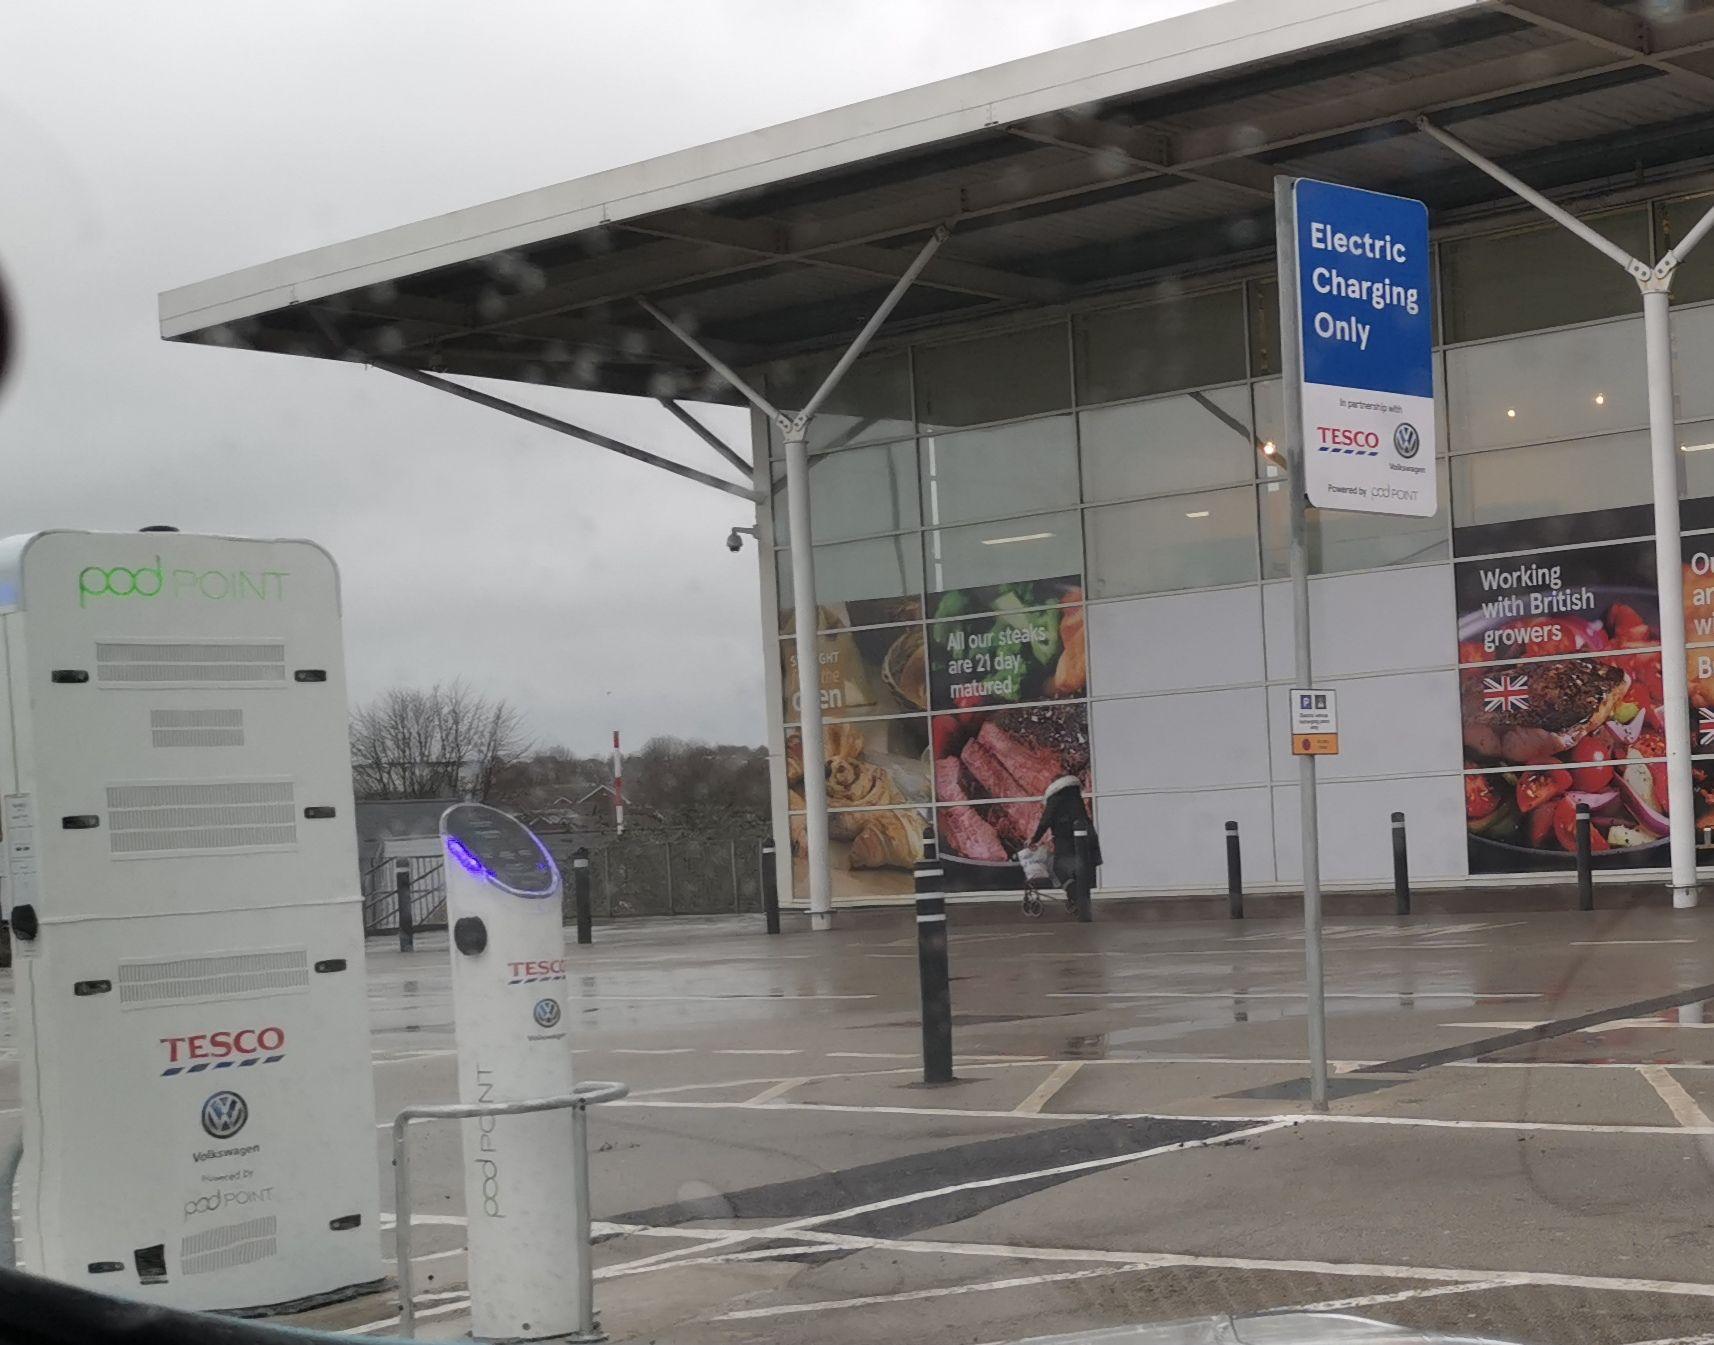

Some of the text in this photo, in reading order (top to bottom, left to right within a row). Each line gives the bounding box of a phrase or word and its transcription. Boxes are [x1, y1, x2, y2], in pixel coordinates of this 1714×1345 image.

[1311, 222, 1407, 263] Electric
[1312, 267, 1419, 315] Charging
[1314, 311, 1371, 350] Only
[1317, 427, 1379, 448] TESCO
[1328, 484, 1358, 495] Powered
[1359, 487, 1367, 498] by
[1391, 489, 1418, 501] POINT
[79, 555, 291, 610] pod POINT
[1480, 563, 1562, 590] Working
[1482, 587, 1595, 619] with British
[947, 623, 1047, 651] All our steaks
[1484, 624, 1562, 653] growers
[948, 652, 1021, 675] are 21 day
[950, 675, 1013, 699] matured
[507, 960, 566, 977] TESC
[160, 1027, 285, 1063] TESCO
[192, 1144, 260, 1163] Volkswagen
[475, 1061, 506, 1219] pod PONT
[223, 1186, 275, 1212] POINT
